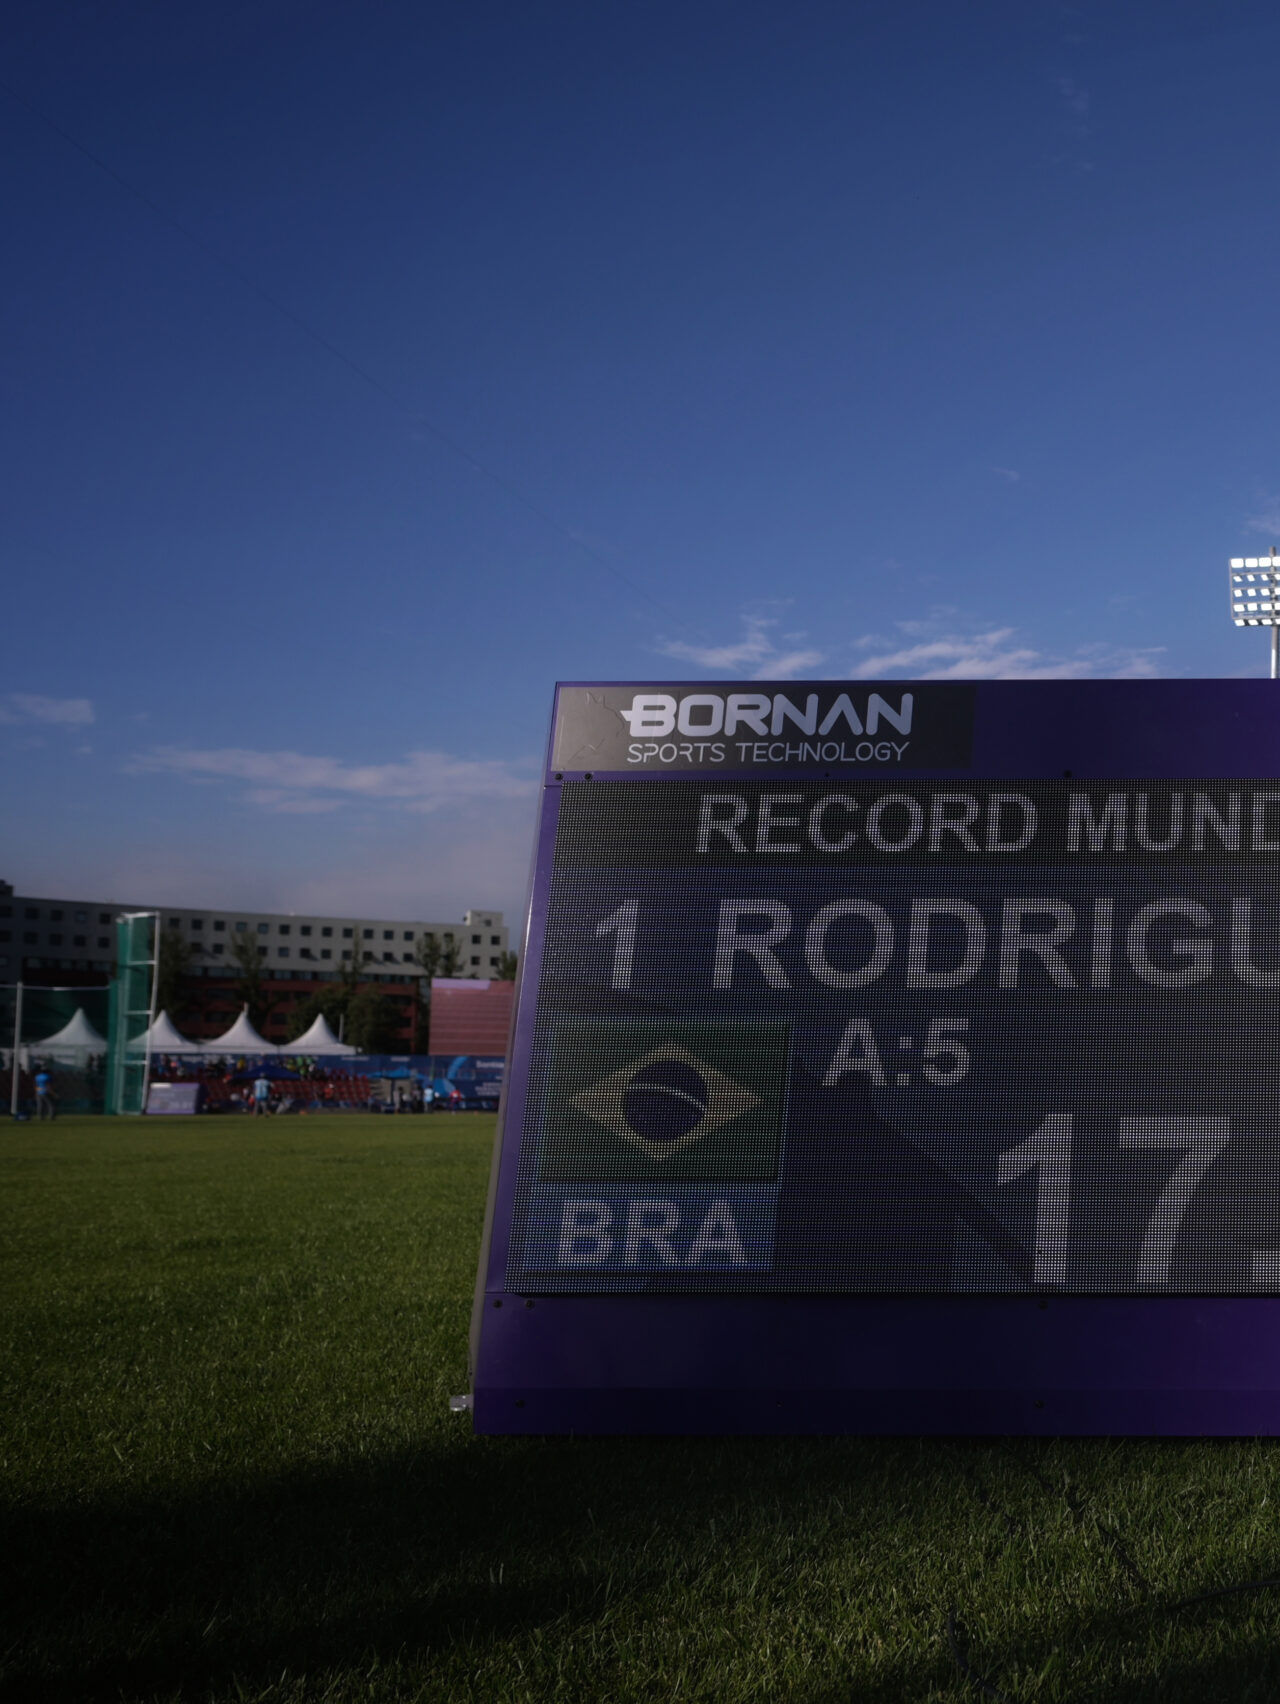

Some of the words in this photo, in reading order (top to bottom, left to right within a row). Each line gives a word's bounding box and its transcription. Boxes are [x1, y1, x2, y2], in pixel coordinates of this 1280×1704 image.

[620, 693, 914, 738] BORNAN
[626, 742, 726, 763] SPORTS
[735, 741, 910, 763] TECHNOLOGY
[696, 793, 1039, 853] RECORD
[595, 898, 641, 989] 1
[821, 1017, 971, 1087] A:5
[556, 1199, 749, 1265] BRA
